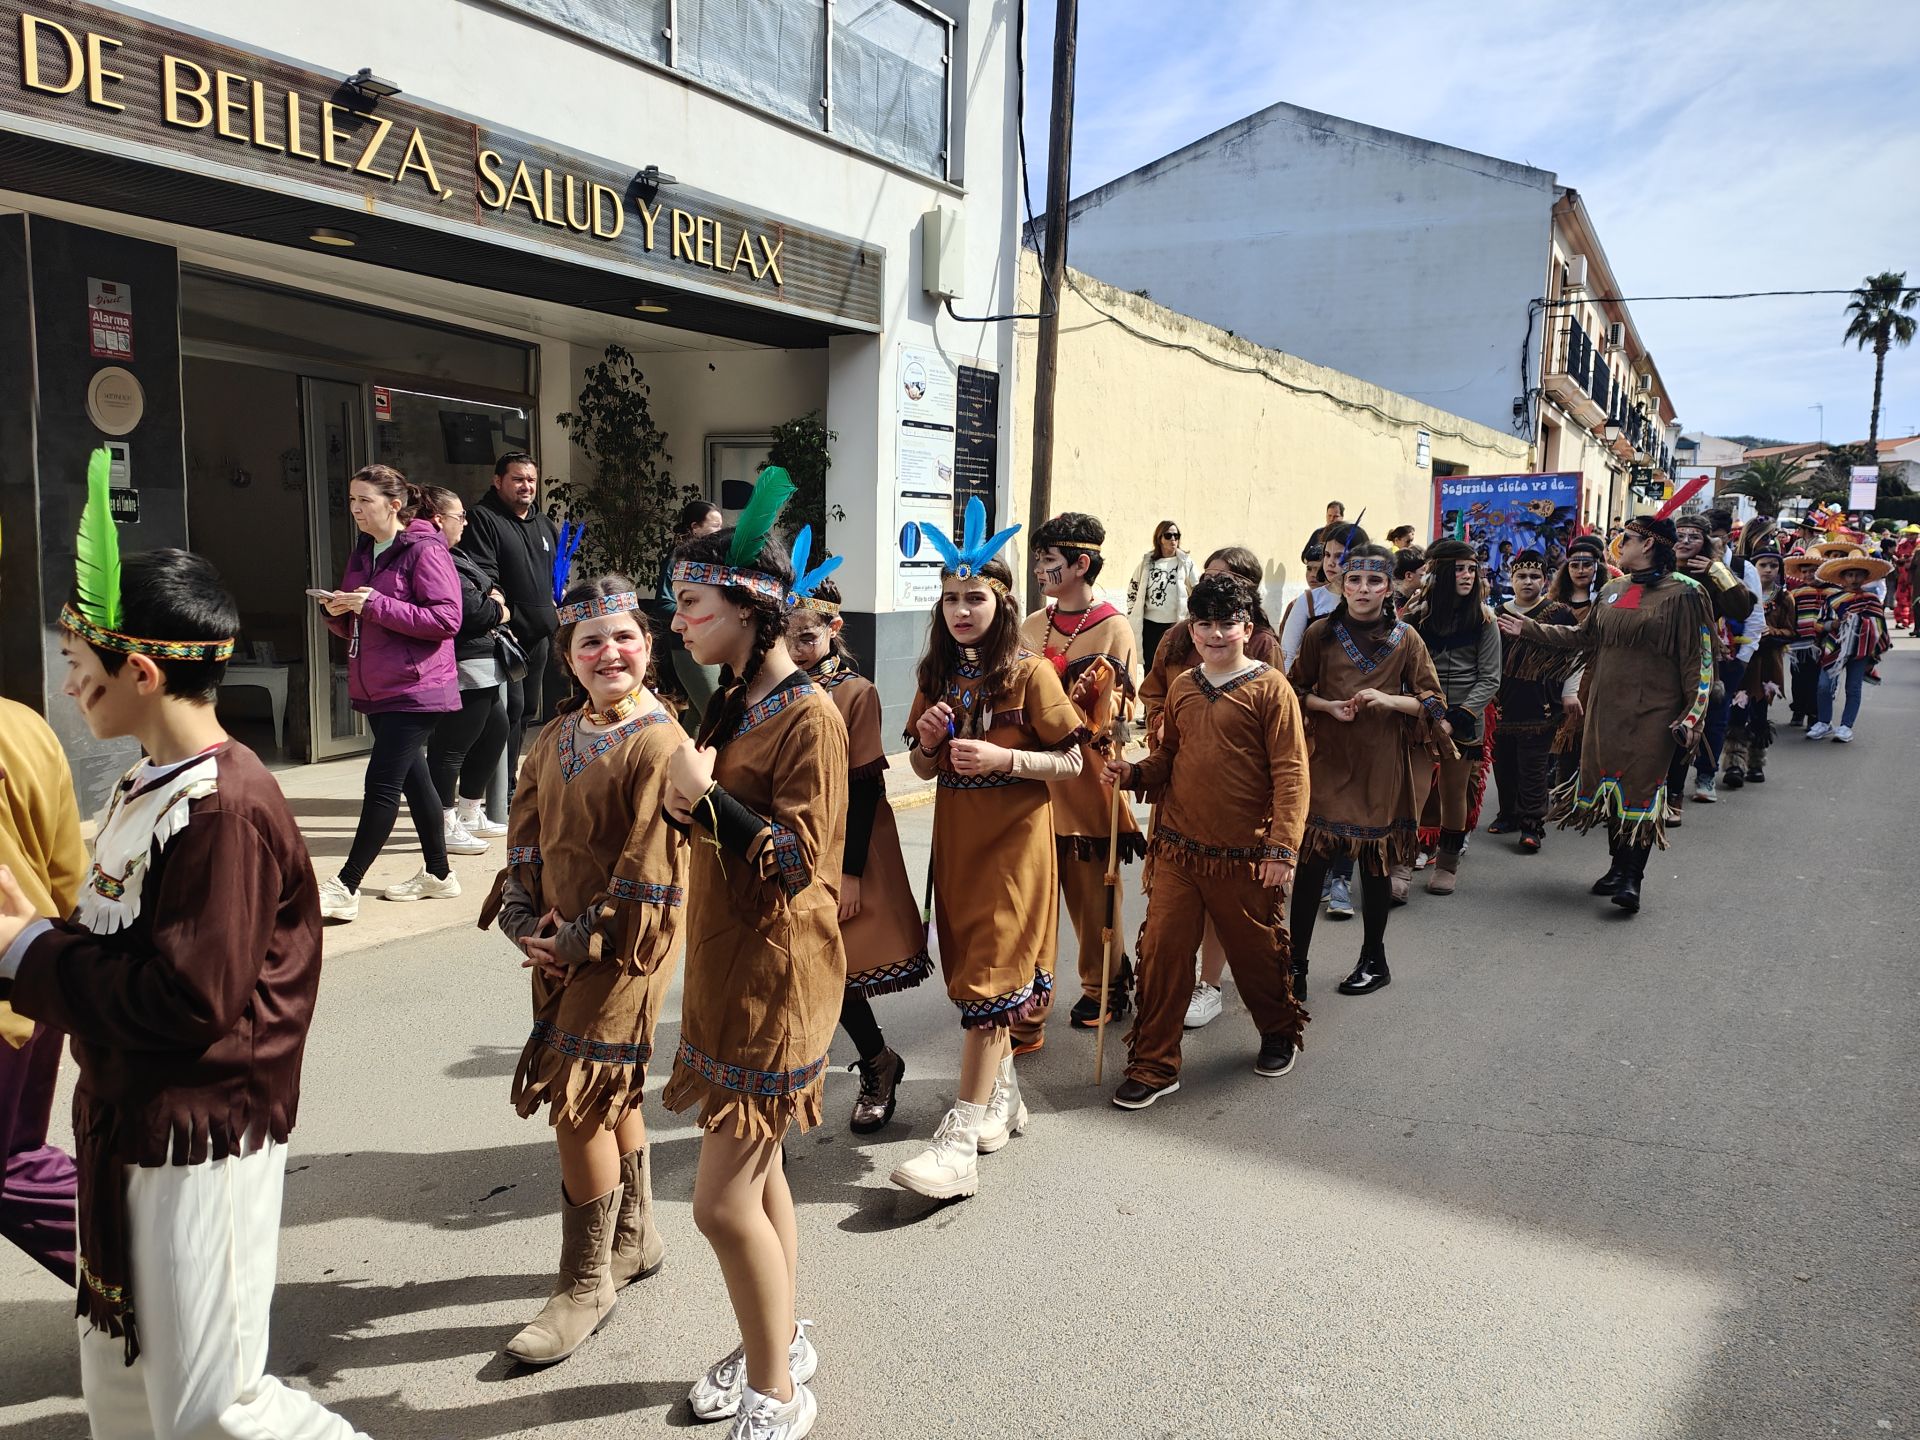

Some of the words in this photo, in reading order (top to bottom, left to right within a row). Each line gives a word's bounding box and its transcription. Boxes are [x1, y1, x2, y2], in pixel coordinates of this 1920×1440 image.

[22, 13, 126, 111] DE
[162, 54, 453, 200] BELLEZA,
[478, 150, 625, 240] SALUD
[637, 198, 662, 251] Y
[671, 208, 784, 286] RELAX
[93, 310, 130, 327] Alarma
[1442, 481, 1494, 496] Segundo
[1498, 480, 1528, 492] ciclo
[1532, 481, 1547, 491] va
